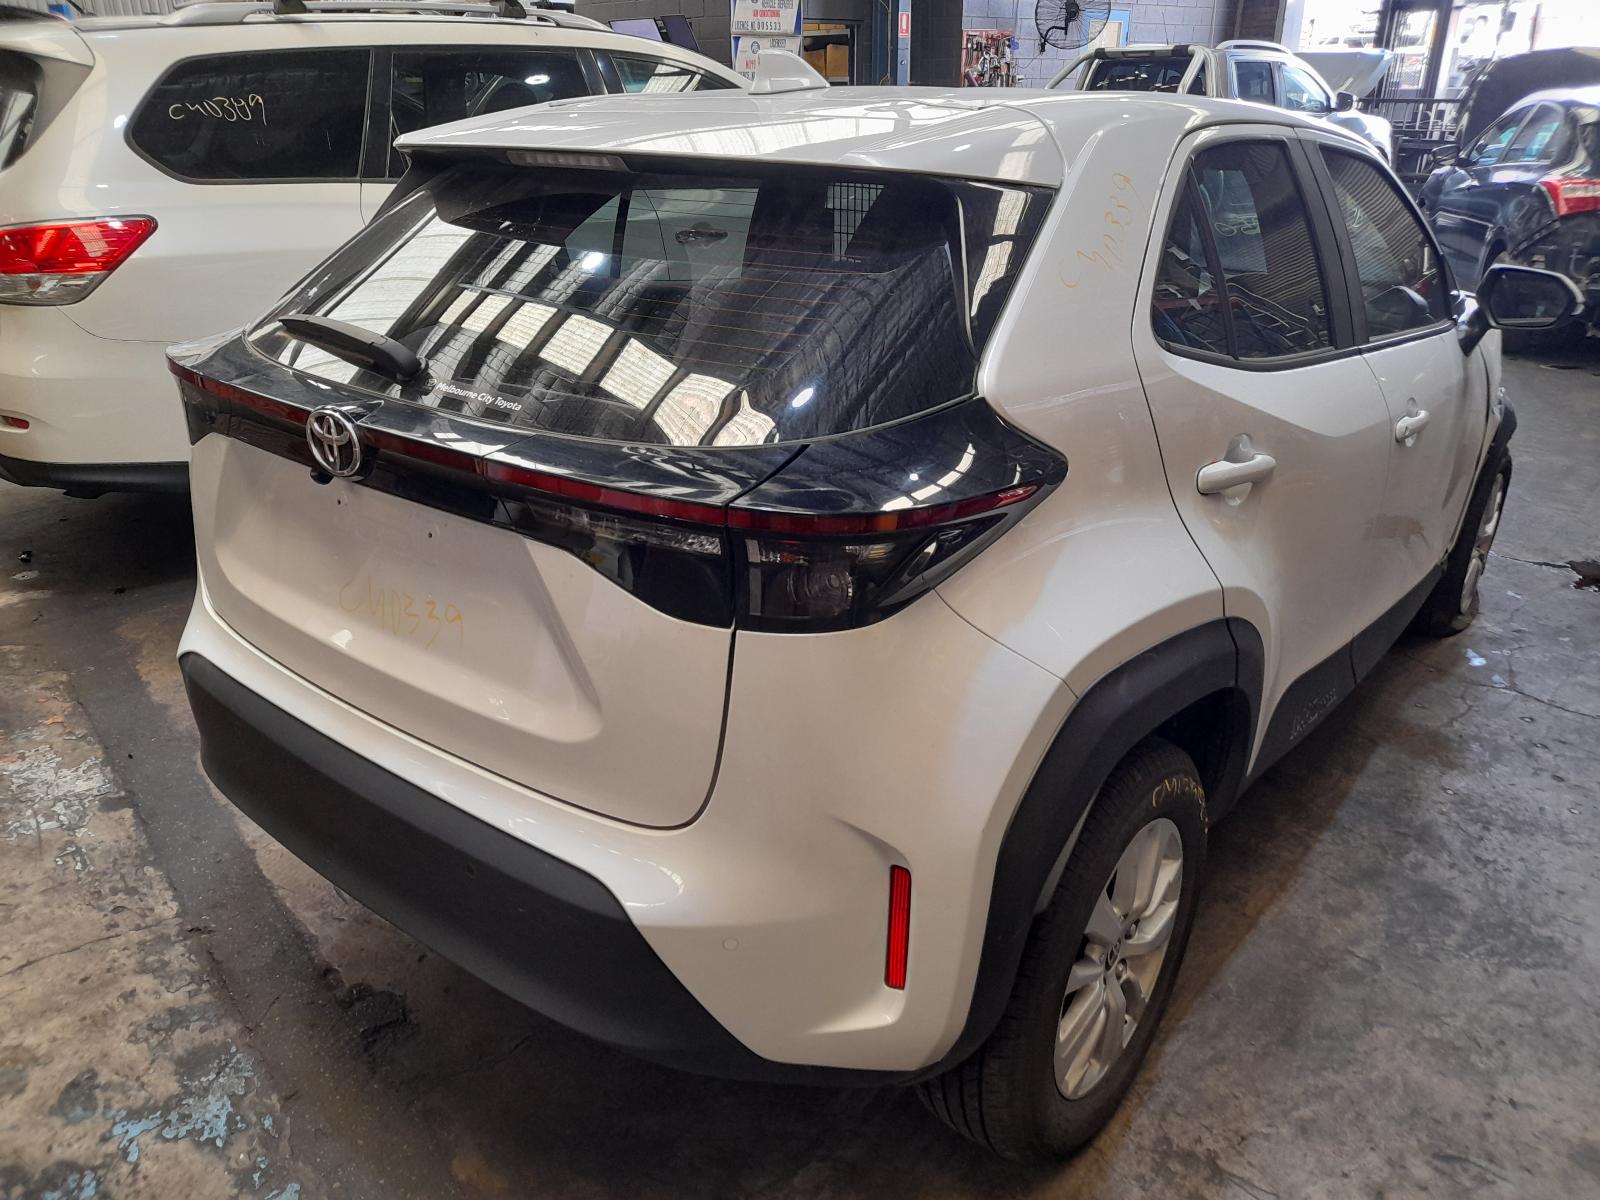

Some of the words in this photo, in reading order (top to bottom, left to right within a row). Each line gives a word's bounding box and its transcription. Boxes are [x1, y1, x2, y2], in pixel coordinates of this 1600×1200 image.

[436, 382, 478, 399] Melbourne
[477, 392, 495, 405] City
[494, 396, 523, 411] Toyota
